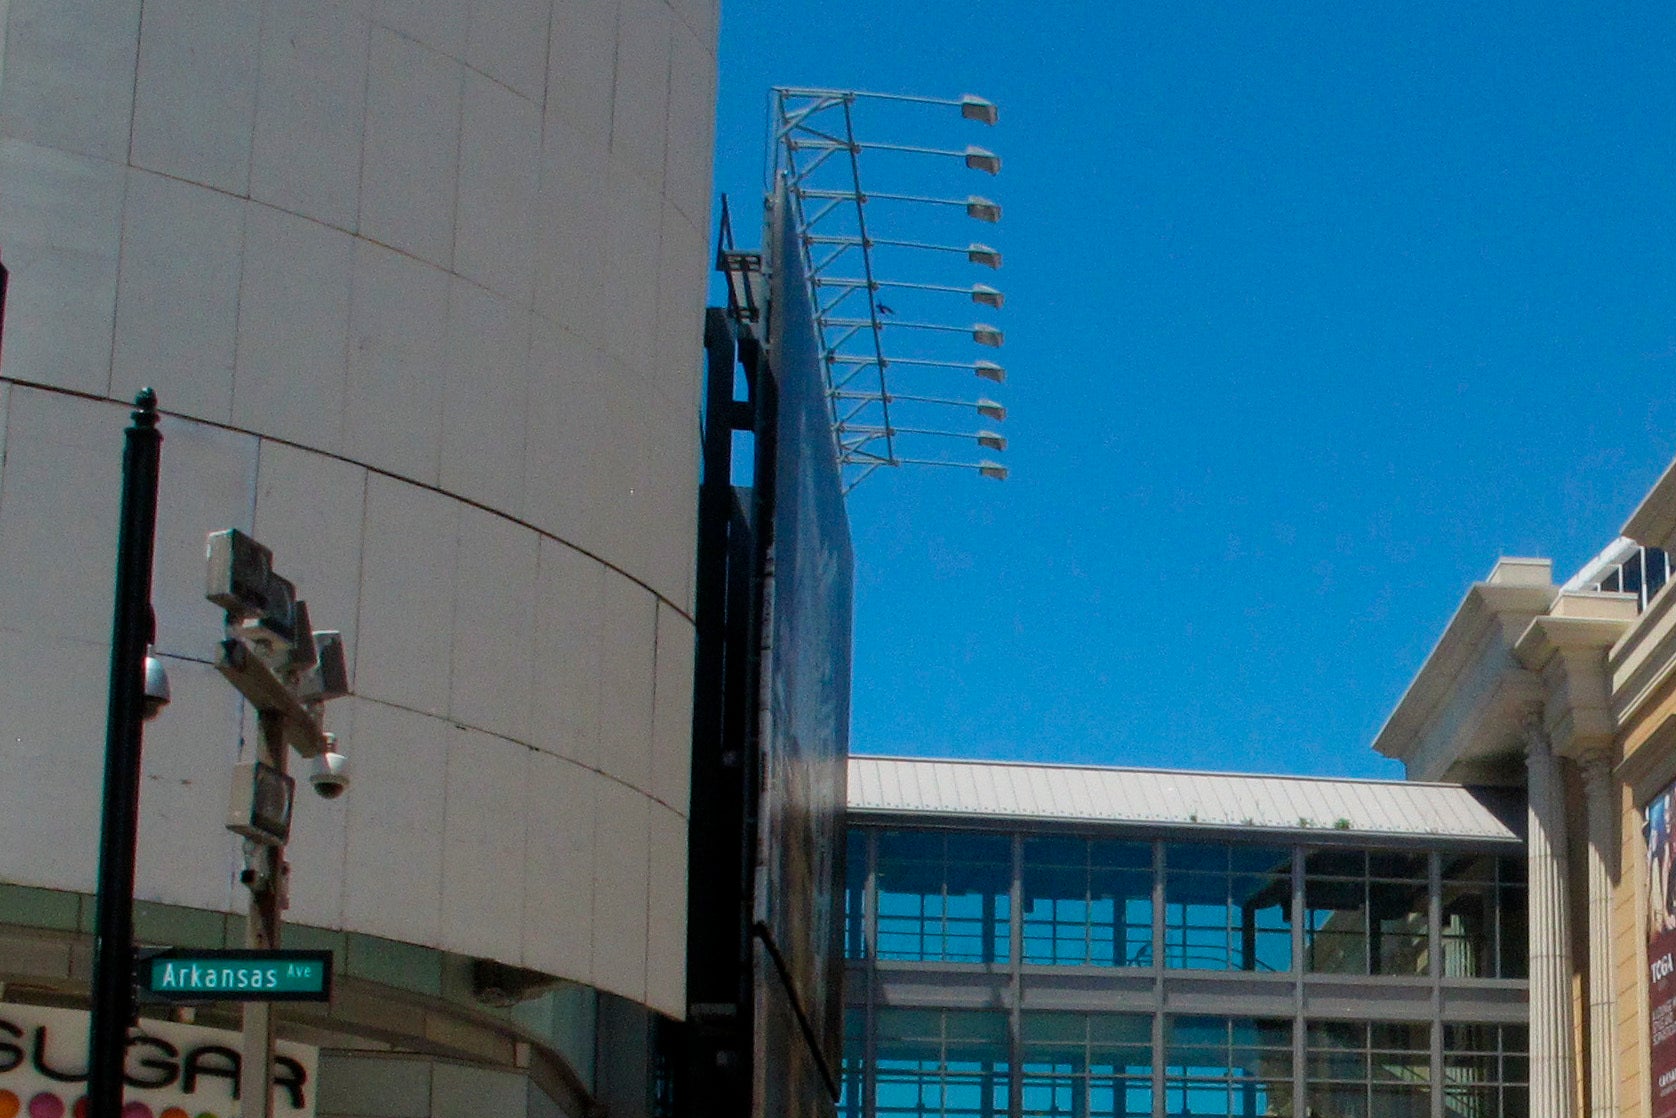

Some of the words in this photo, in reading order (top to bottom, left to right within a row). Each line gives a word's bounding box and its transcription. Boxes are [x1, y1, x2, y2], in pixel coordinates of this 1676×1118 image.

[162, 962, 278, 988] Arkansas
[287, 964, 312, 978] Ave
[1650, 953, 1675, 984] TOGA
